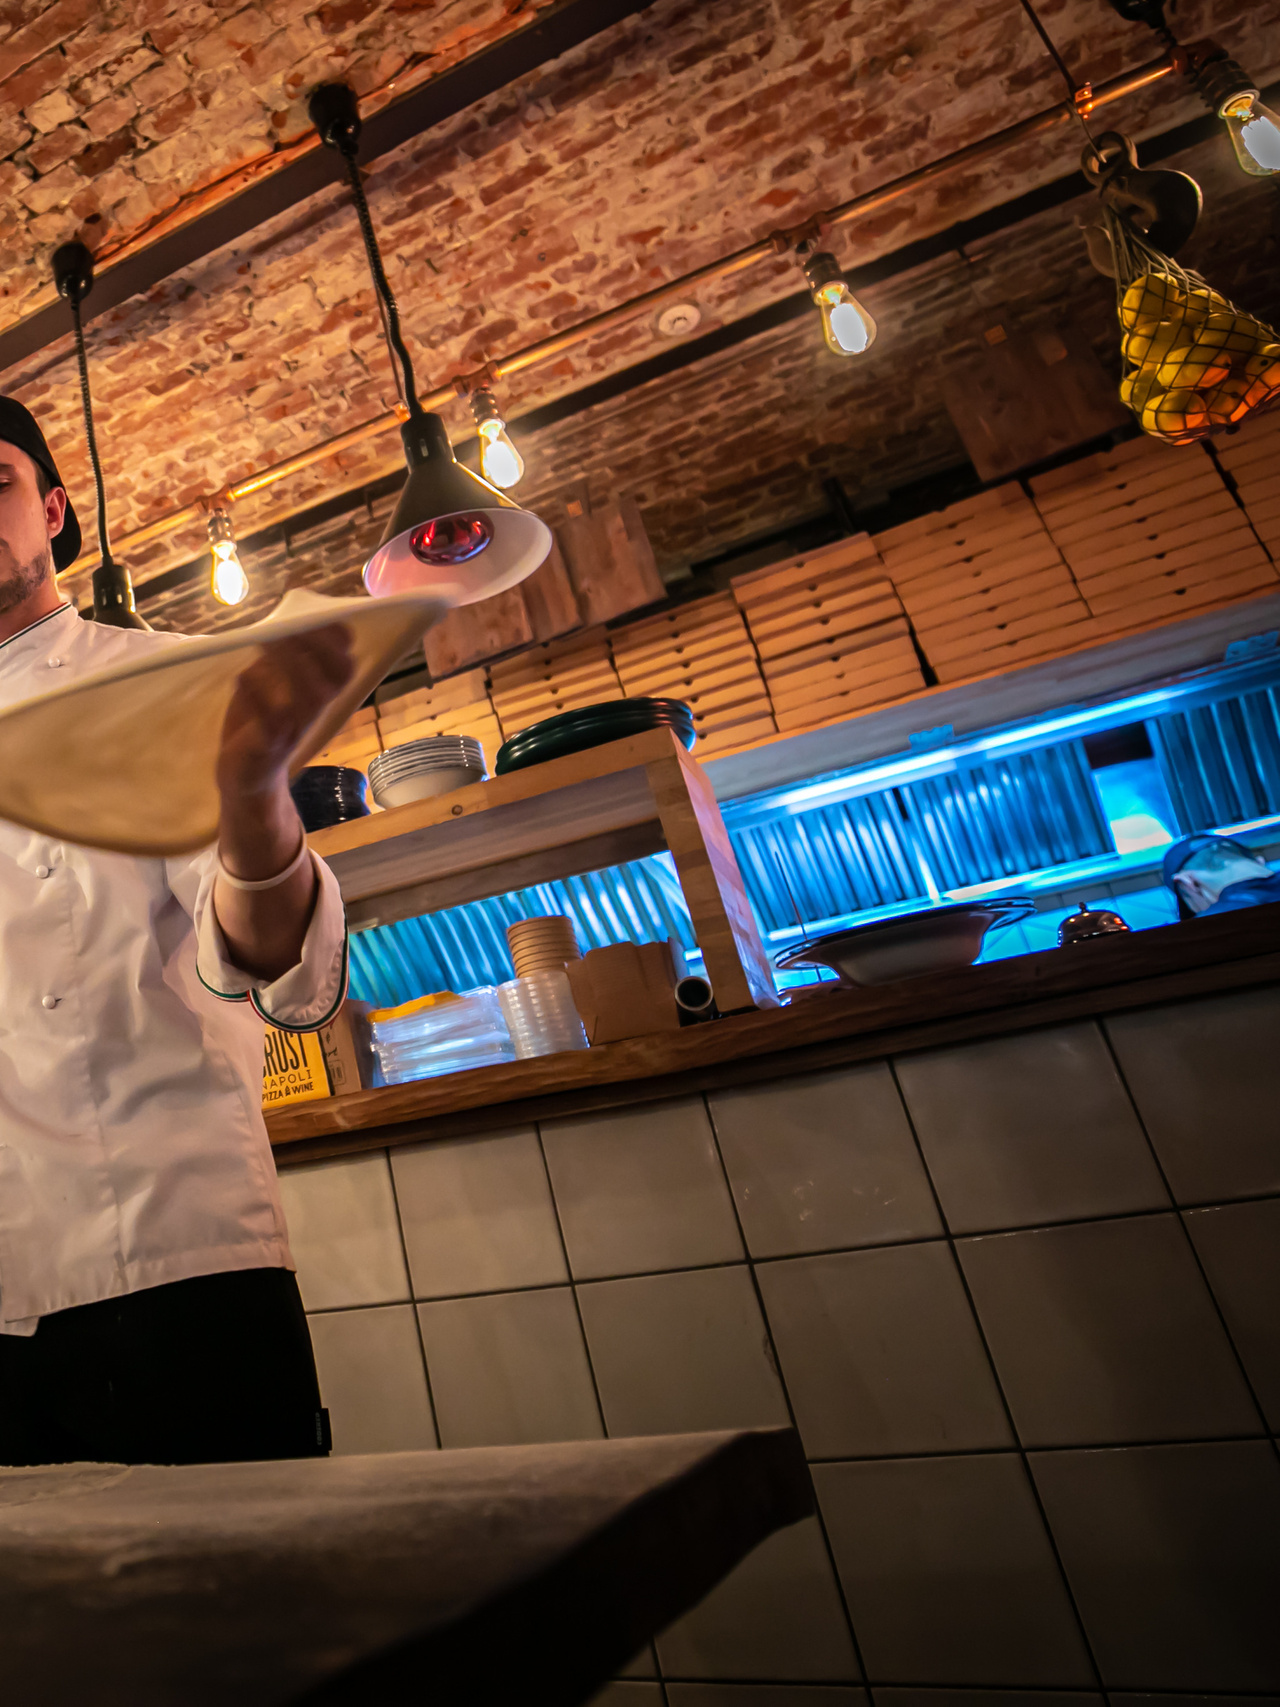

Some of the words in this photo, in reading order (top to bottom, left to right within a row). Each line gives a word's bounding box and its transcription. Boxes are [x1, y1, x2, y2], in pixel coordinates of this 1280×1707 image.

[263, 1031, 308, 1078] RUST
[262, 1090, 284, 1102] PIZZA
[291, 1081, 314, 1095] WINE
